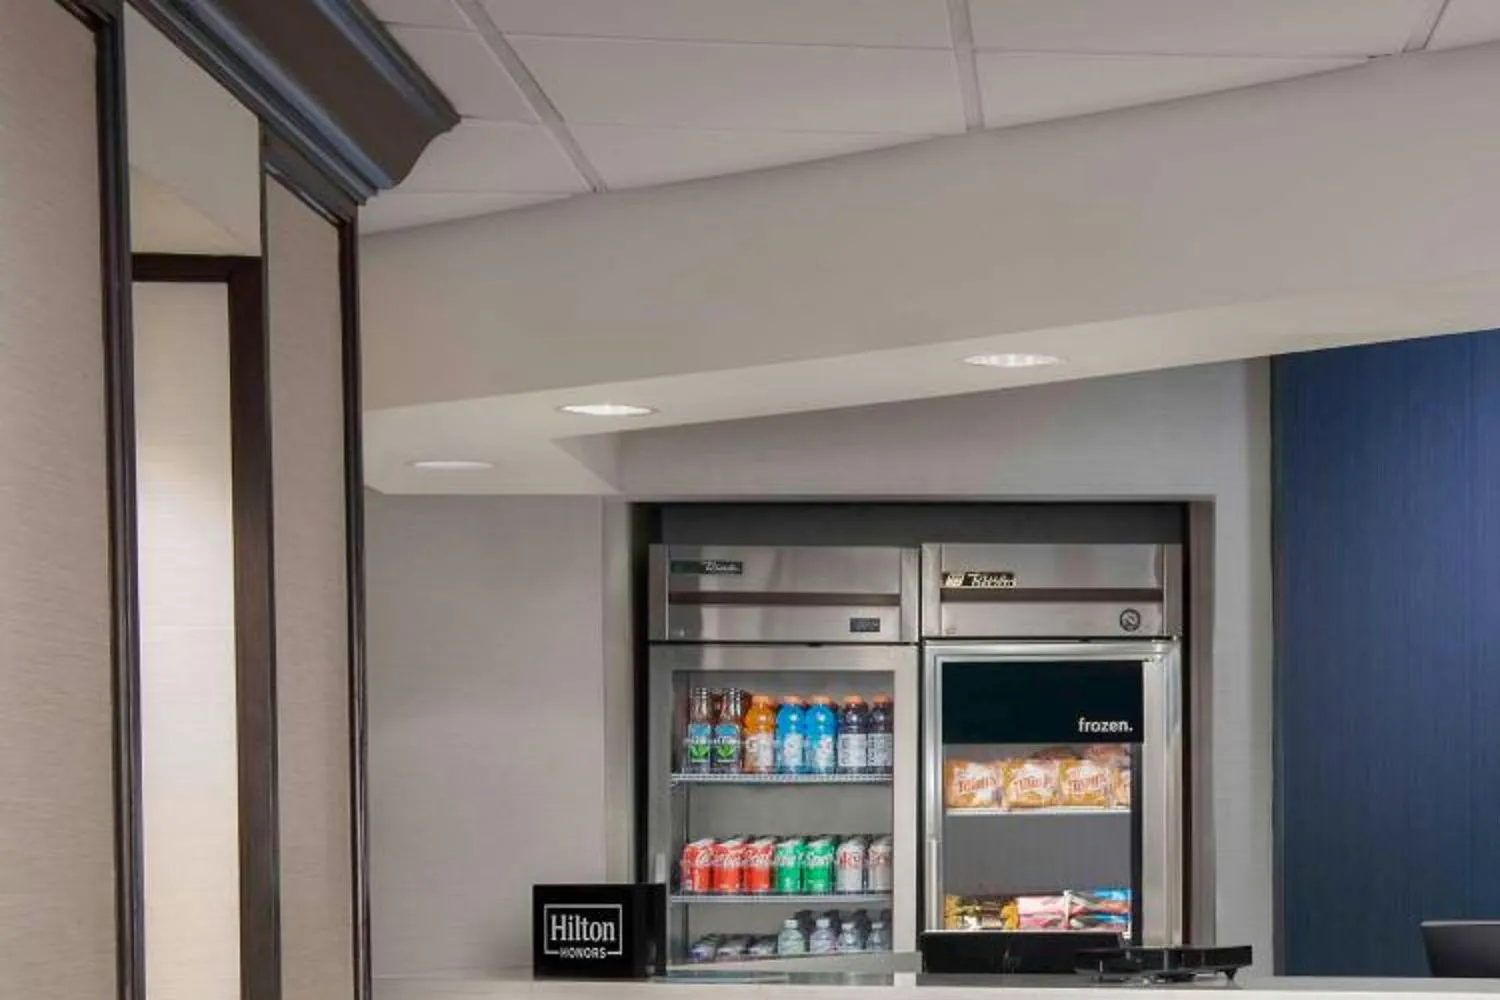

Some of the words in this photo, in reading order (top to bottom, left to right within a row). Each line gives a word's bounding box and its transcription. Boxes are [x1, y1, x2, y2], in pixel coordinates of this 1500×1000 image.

[1078, 717, 1133, 733] frozen.
[551, 914, 615, 942] Hilton
[560, 947, 607, 959] HONORS
